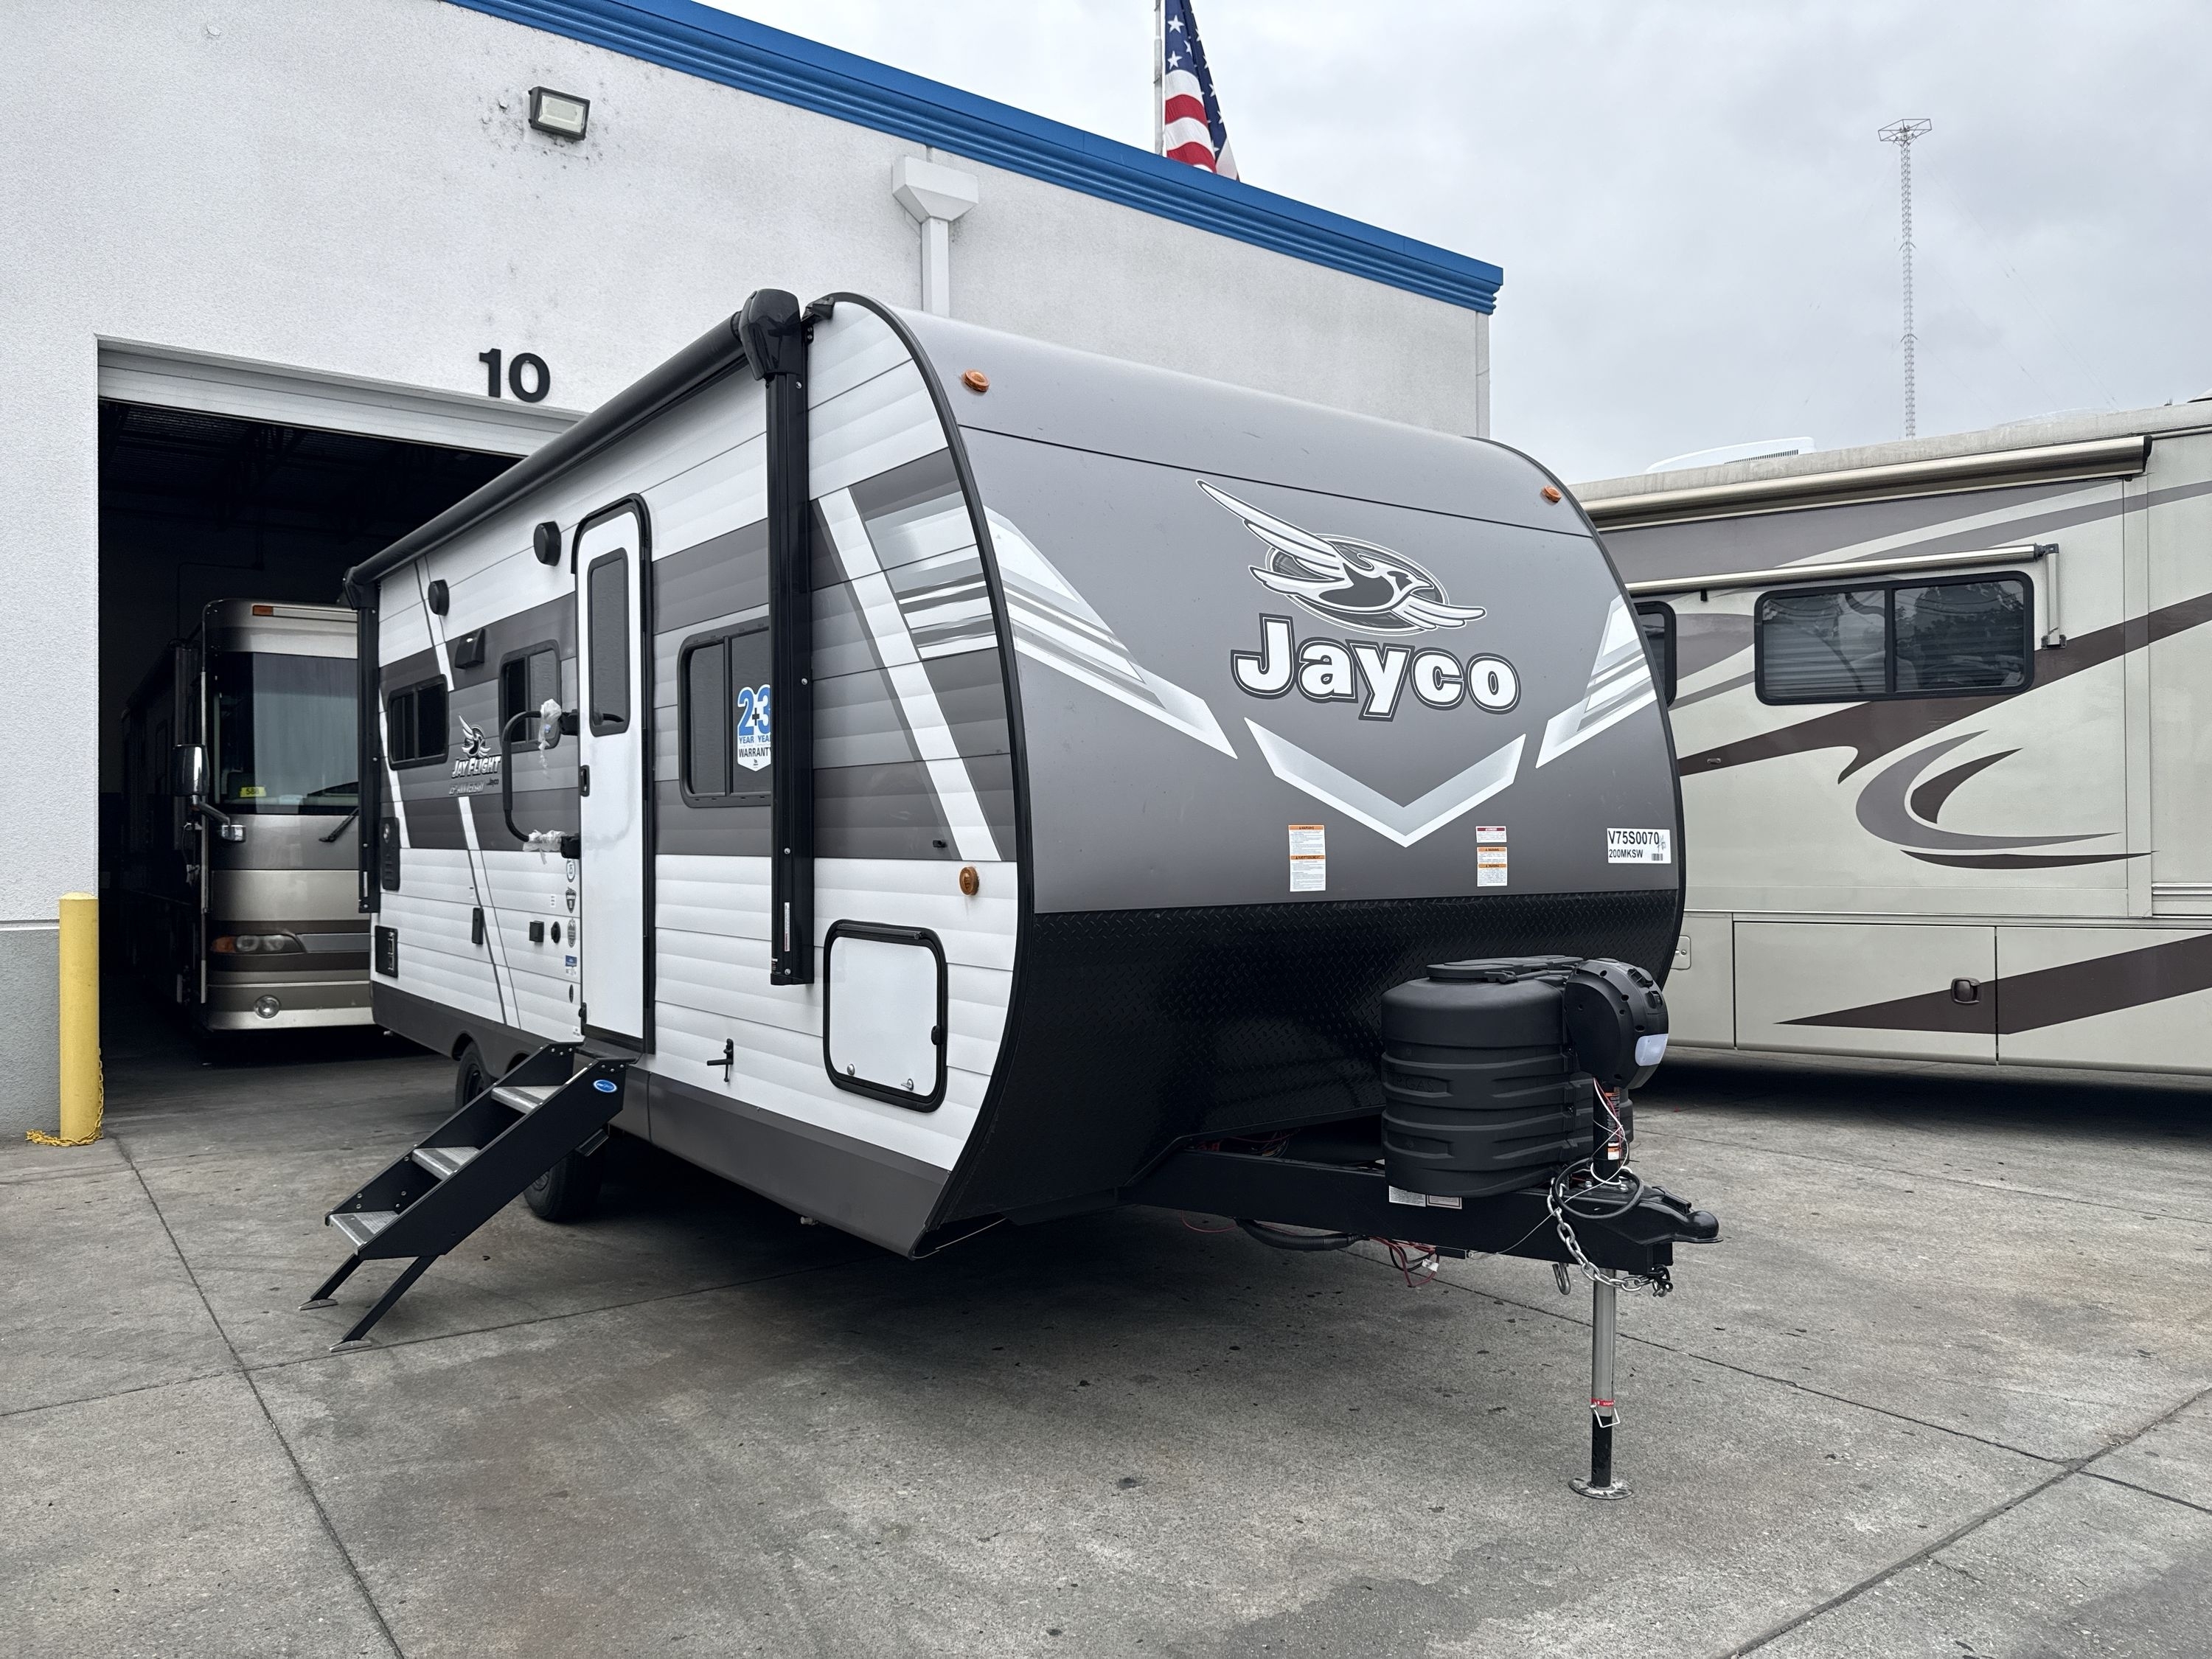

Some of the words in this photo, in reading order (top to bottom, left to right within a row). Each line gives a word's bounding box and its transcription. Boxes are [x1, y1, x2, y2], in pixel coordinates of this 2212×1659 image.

[479, 347, 551, 403] 10
[1231, 613, 1522, 722] Jayco
[757, 735, 771, 743] YEA
[451, 759, 469, 778] JAY
[467, 755, 501, 776] FLIGHT
[1608, 830, 1660, 845] V75S0070
[1609, 849, 1644, 858] 200MKSW
